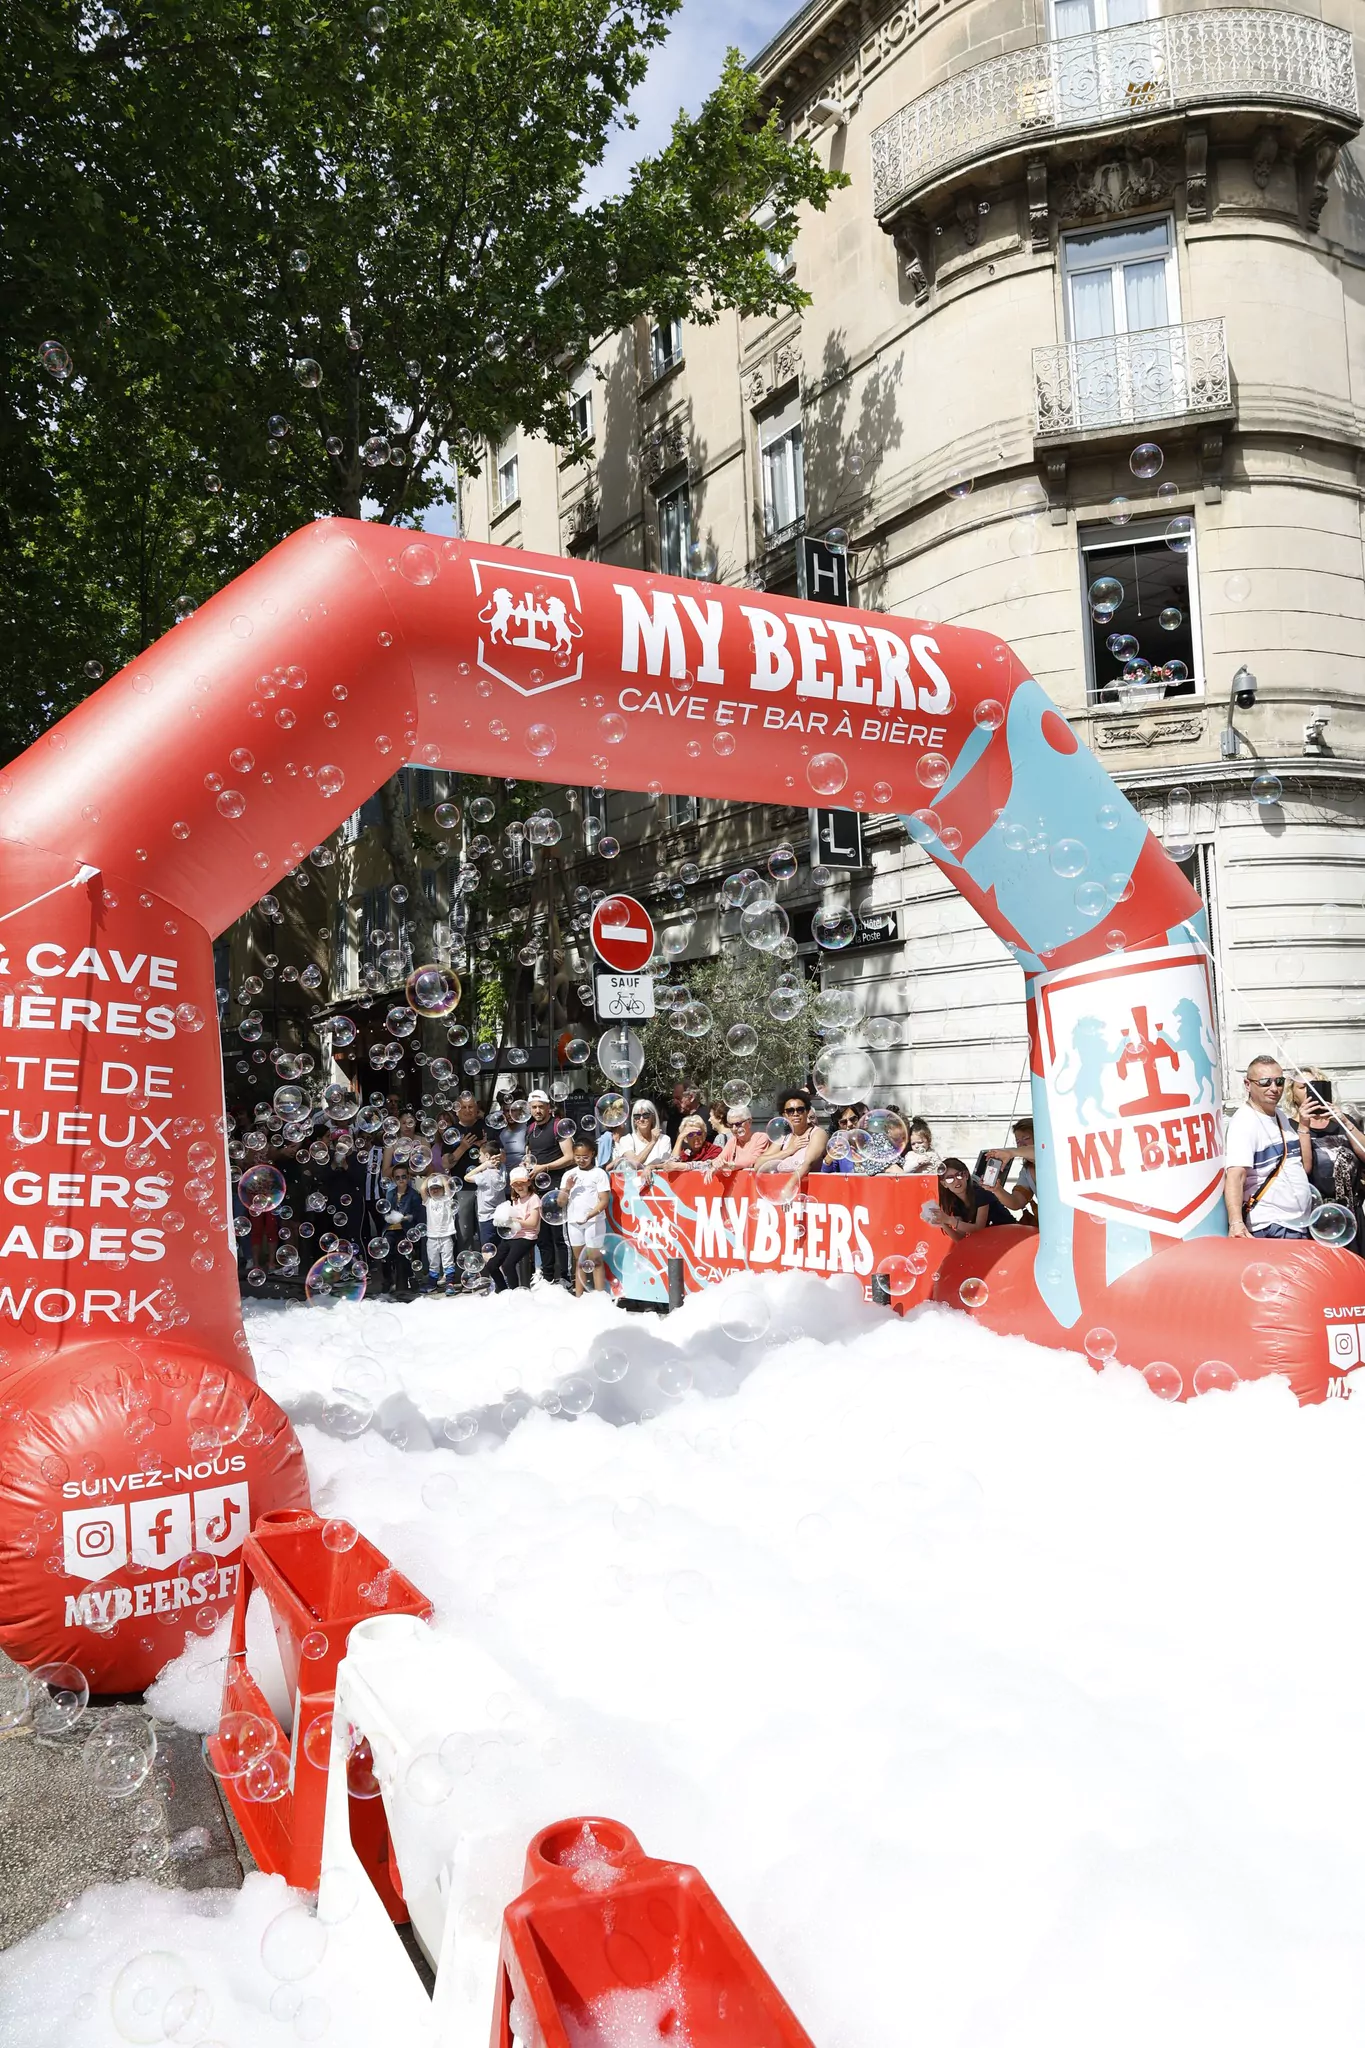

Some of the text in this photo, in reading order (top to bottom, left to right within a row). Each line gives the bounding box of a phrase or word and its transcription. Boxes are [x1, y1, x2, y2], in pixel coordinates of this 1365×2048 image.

[612, 584, 951, 714] MY BEERS
[618, 688, 947, 749] CAVE ET BAR À BIÈRE
[862, 931, 881, 942] Poste
[26, 942, 178, 991] CAVE
[611, 977, 640, 988] SAUF
[0, 1056, 174, 1099] TE DE
[0, 1109, 172, 1150] UEUX
[1067, 1128, 1125, 1182] MY
[0, 1171, 170, 1210] GERS
[62, 1455, 246, 1499] SUIVEZ-NOUS
